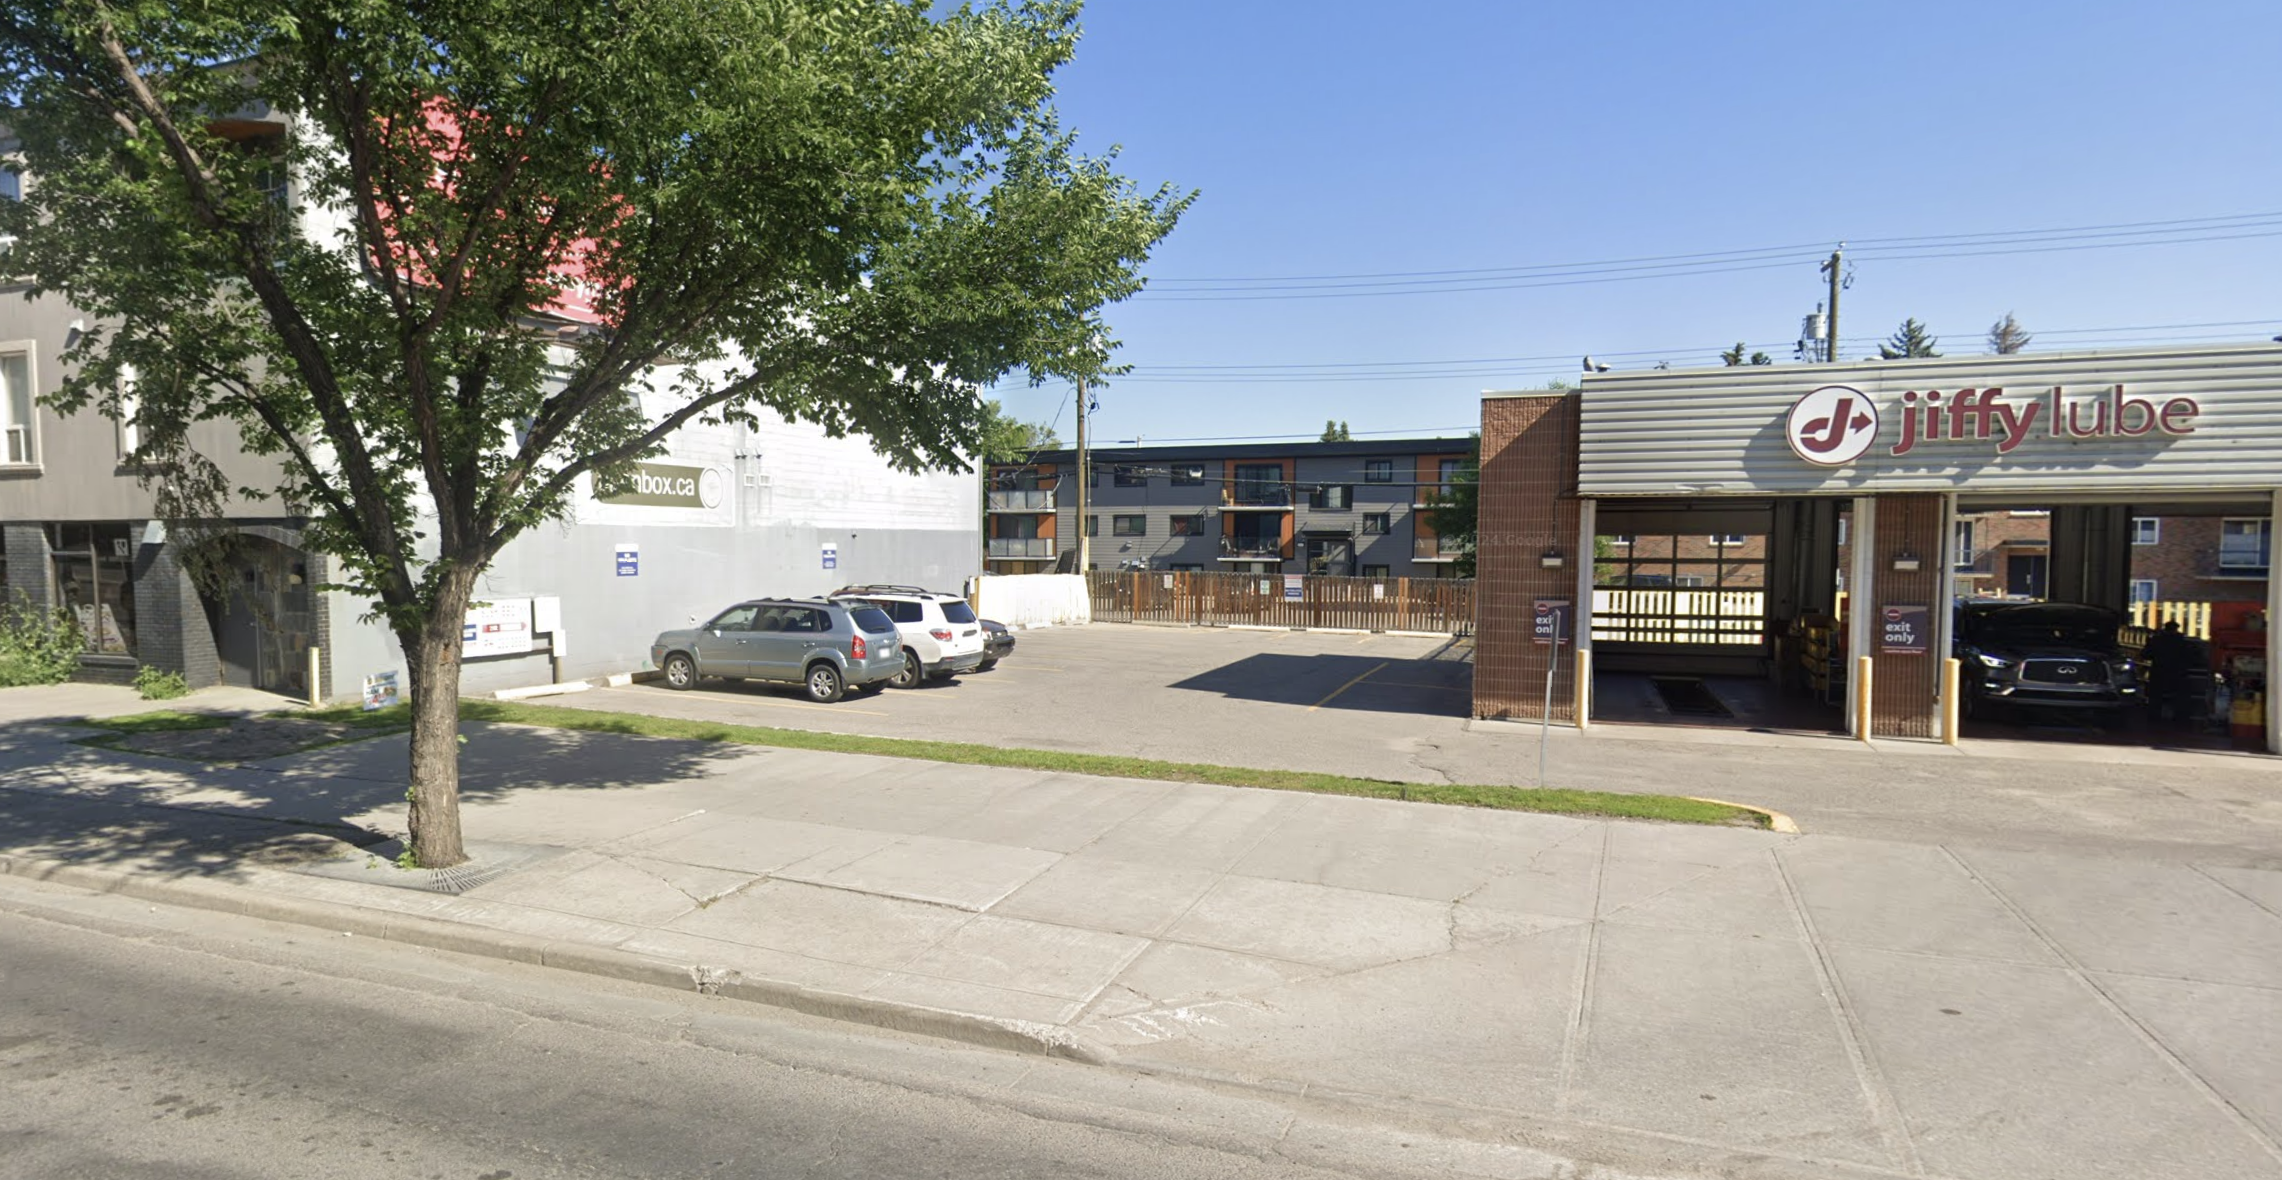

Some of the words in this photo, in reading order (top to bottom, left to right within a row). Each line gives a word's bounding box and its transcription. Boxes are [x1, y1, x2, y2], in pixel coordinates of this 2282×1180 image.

[1889, 388, 2043, 455] jiffy
[2050, 384, 2200, 437] lube
[1535, 614, 1554, 625] exi
[1535, 624, 1553, 634] onl
[1885, 621, 1912, 632] exit
[1885, 631, 1916, 645] only
